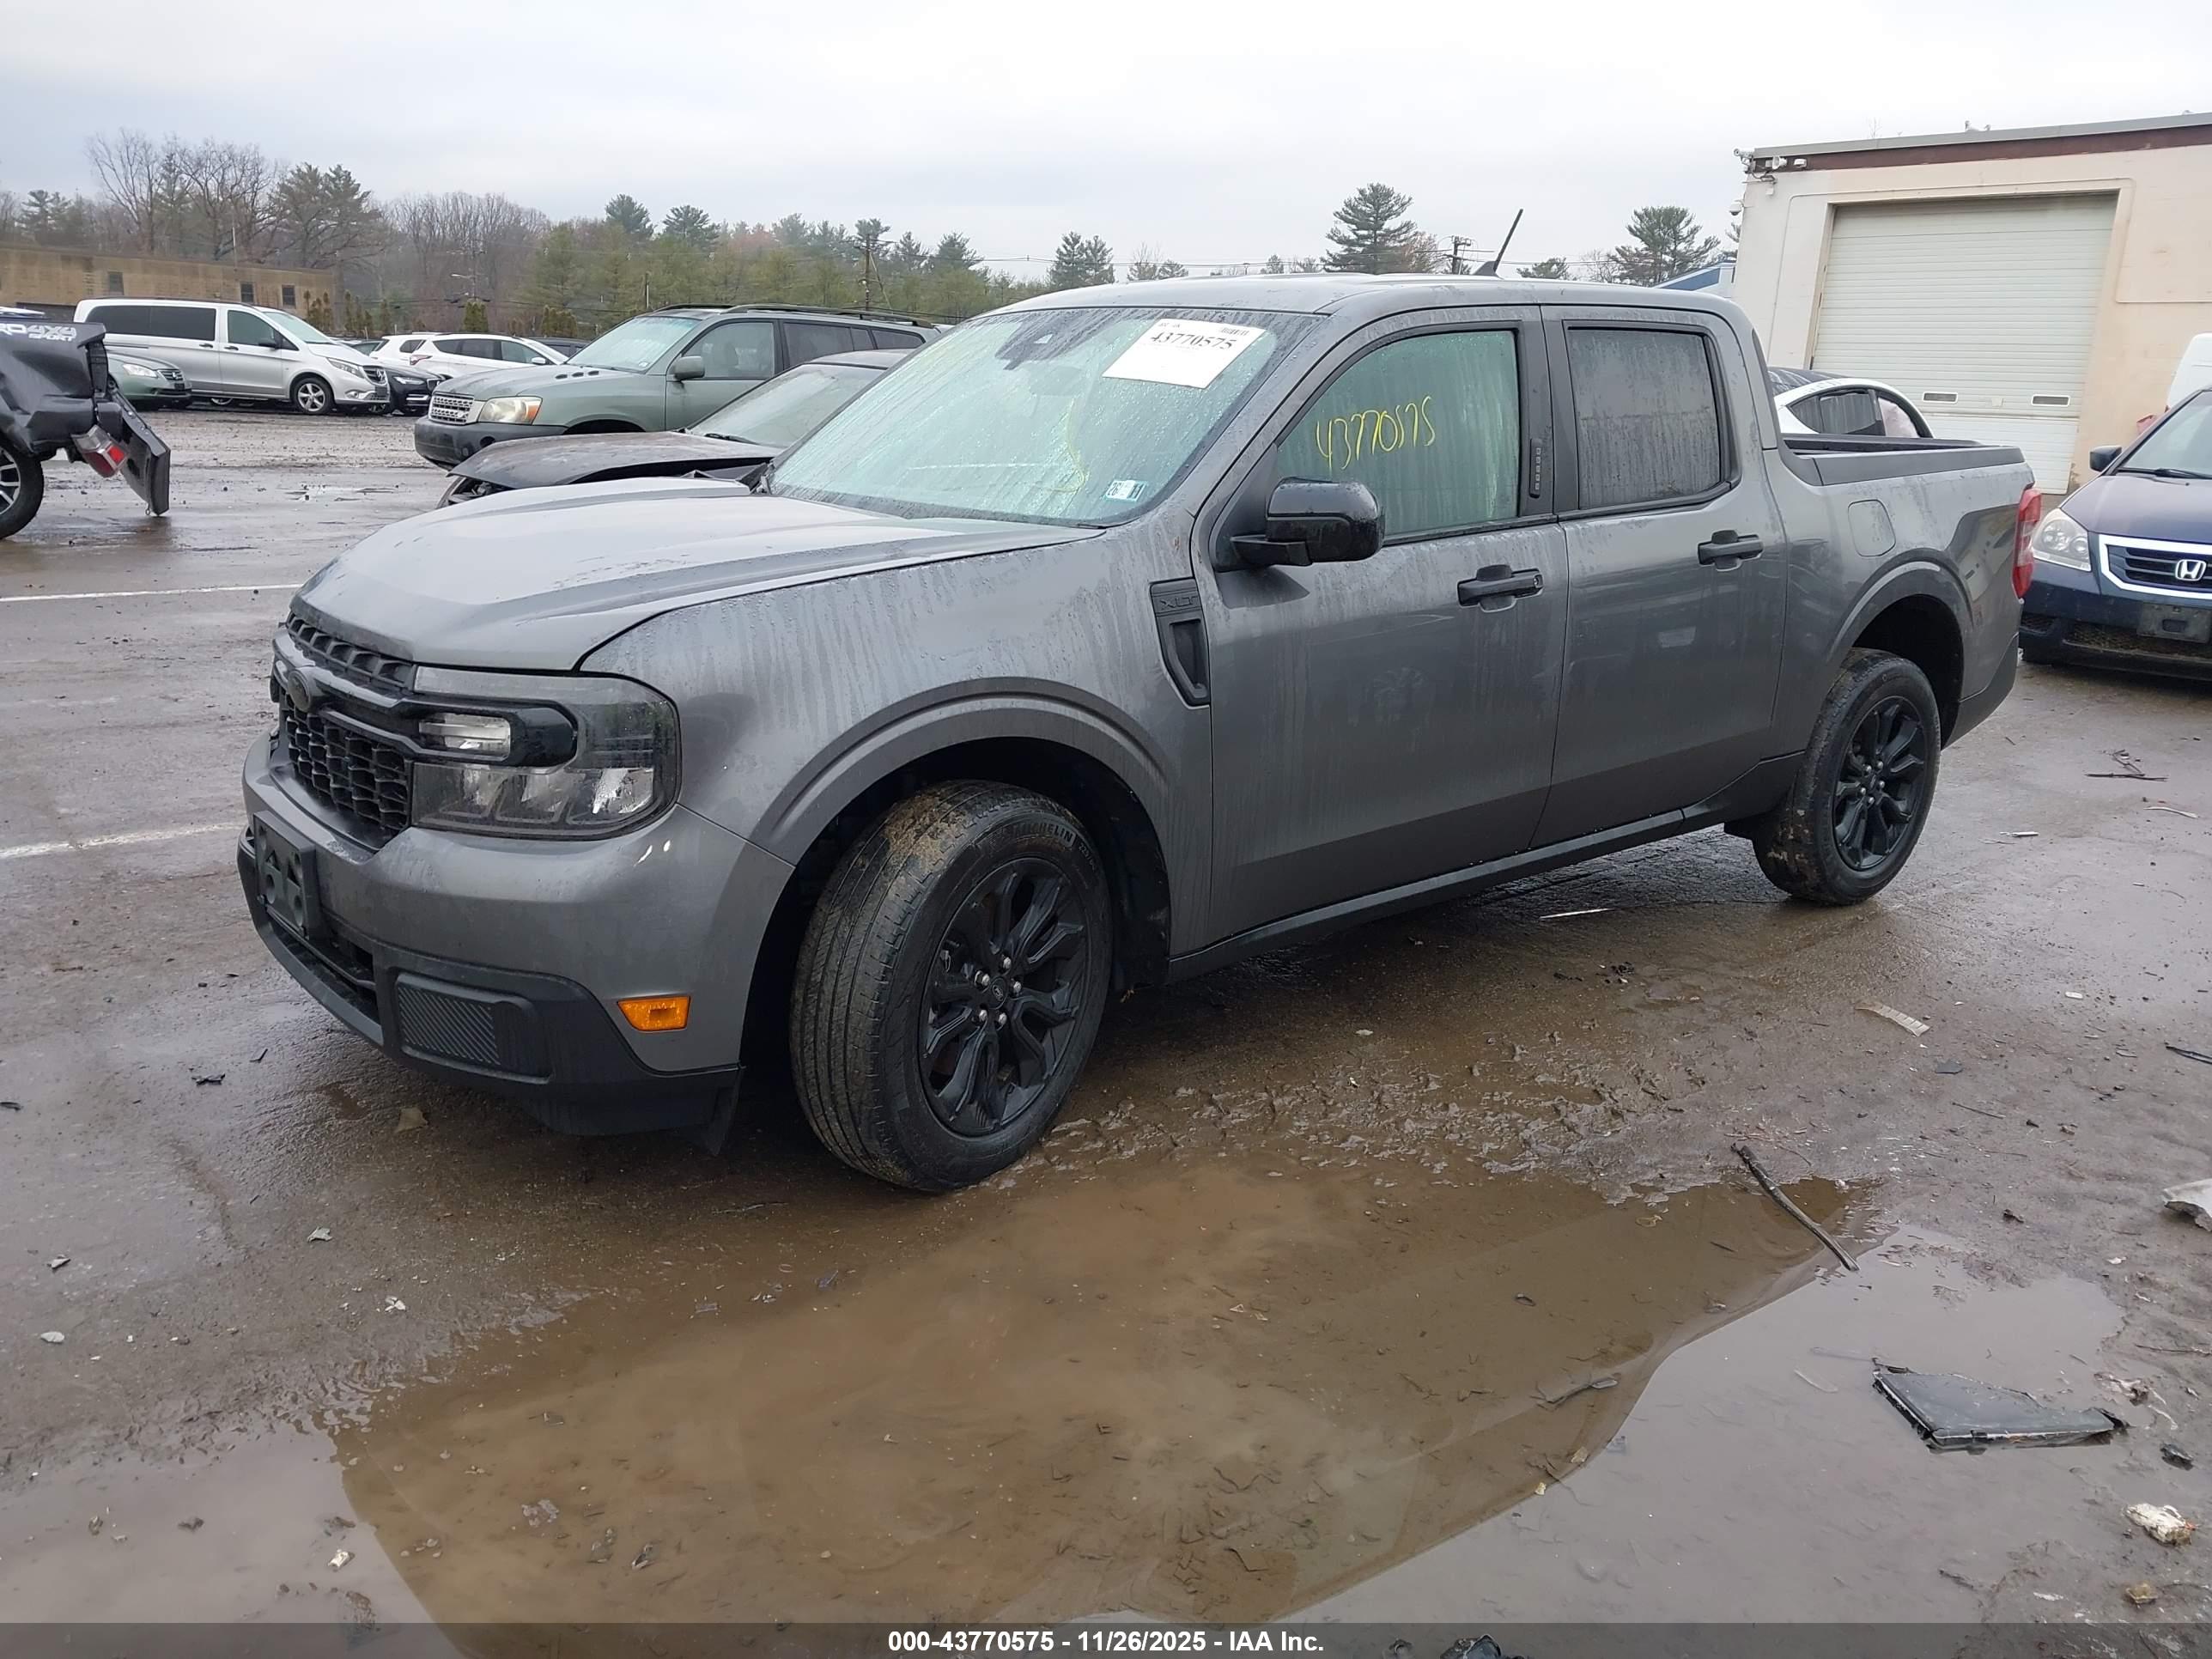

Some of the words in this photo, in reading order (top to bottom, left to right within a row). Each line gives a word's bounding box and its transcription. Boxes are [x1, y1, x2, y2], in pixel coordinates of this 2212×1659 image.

[1150, 331, 1237, 350] 43770575
[1315, 394, 1437, 474] 43770575
[1159, 596, 1199, 611] XLT
[1017, 823, 1073, 842] HELIN
